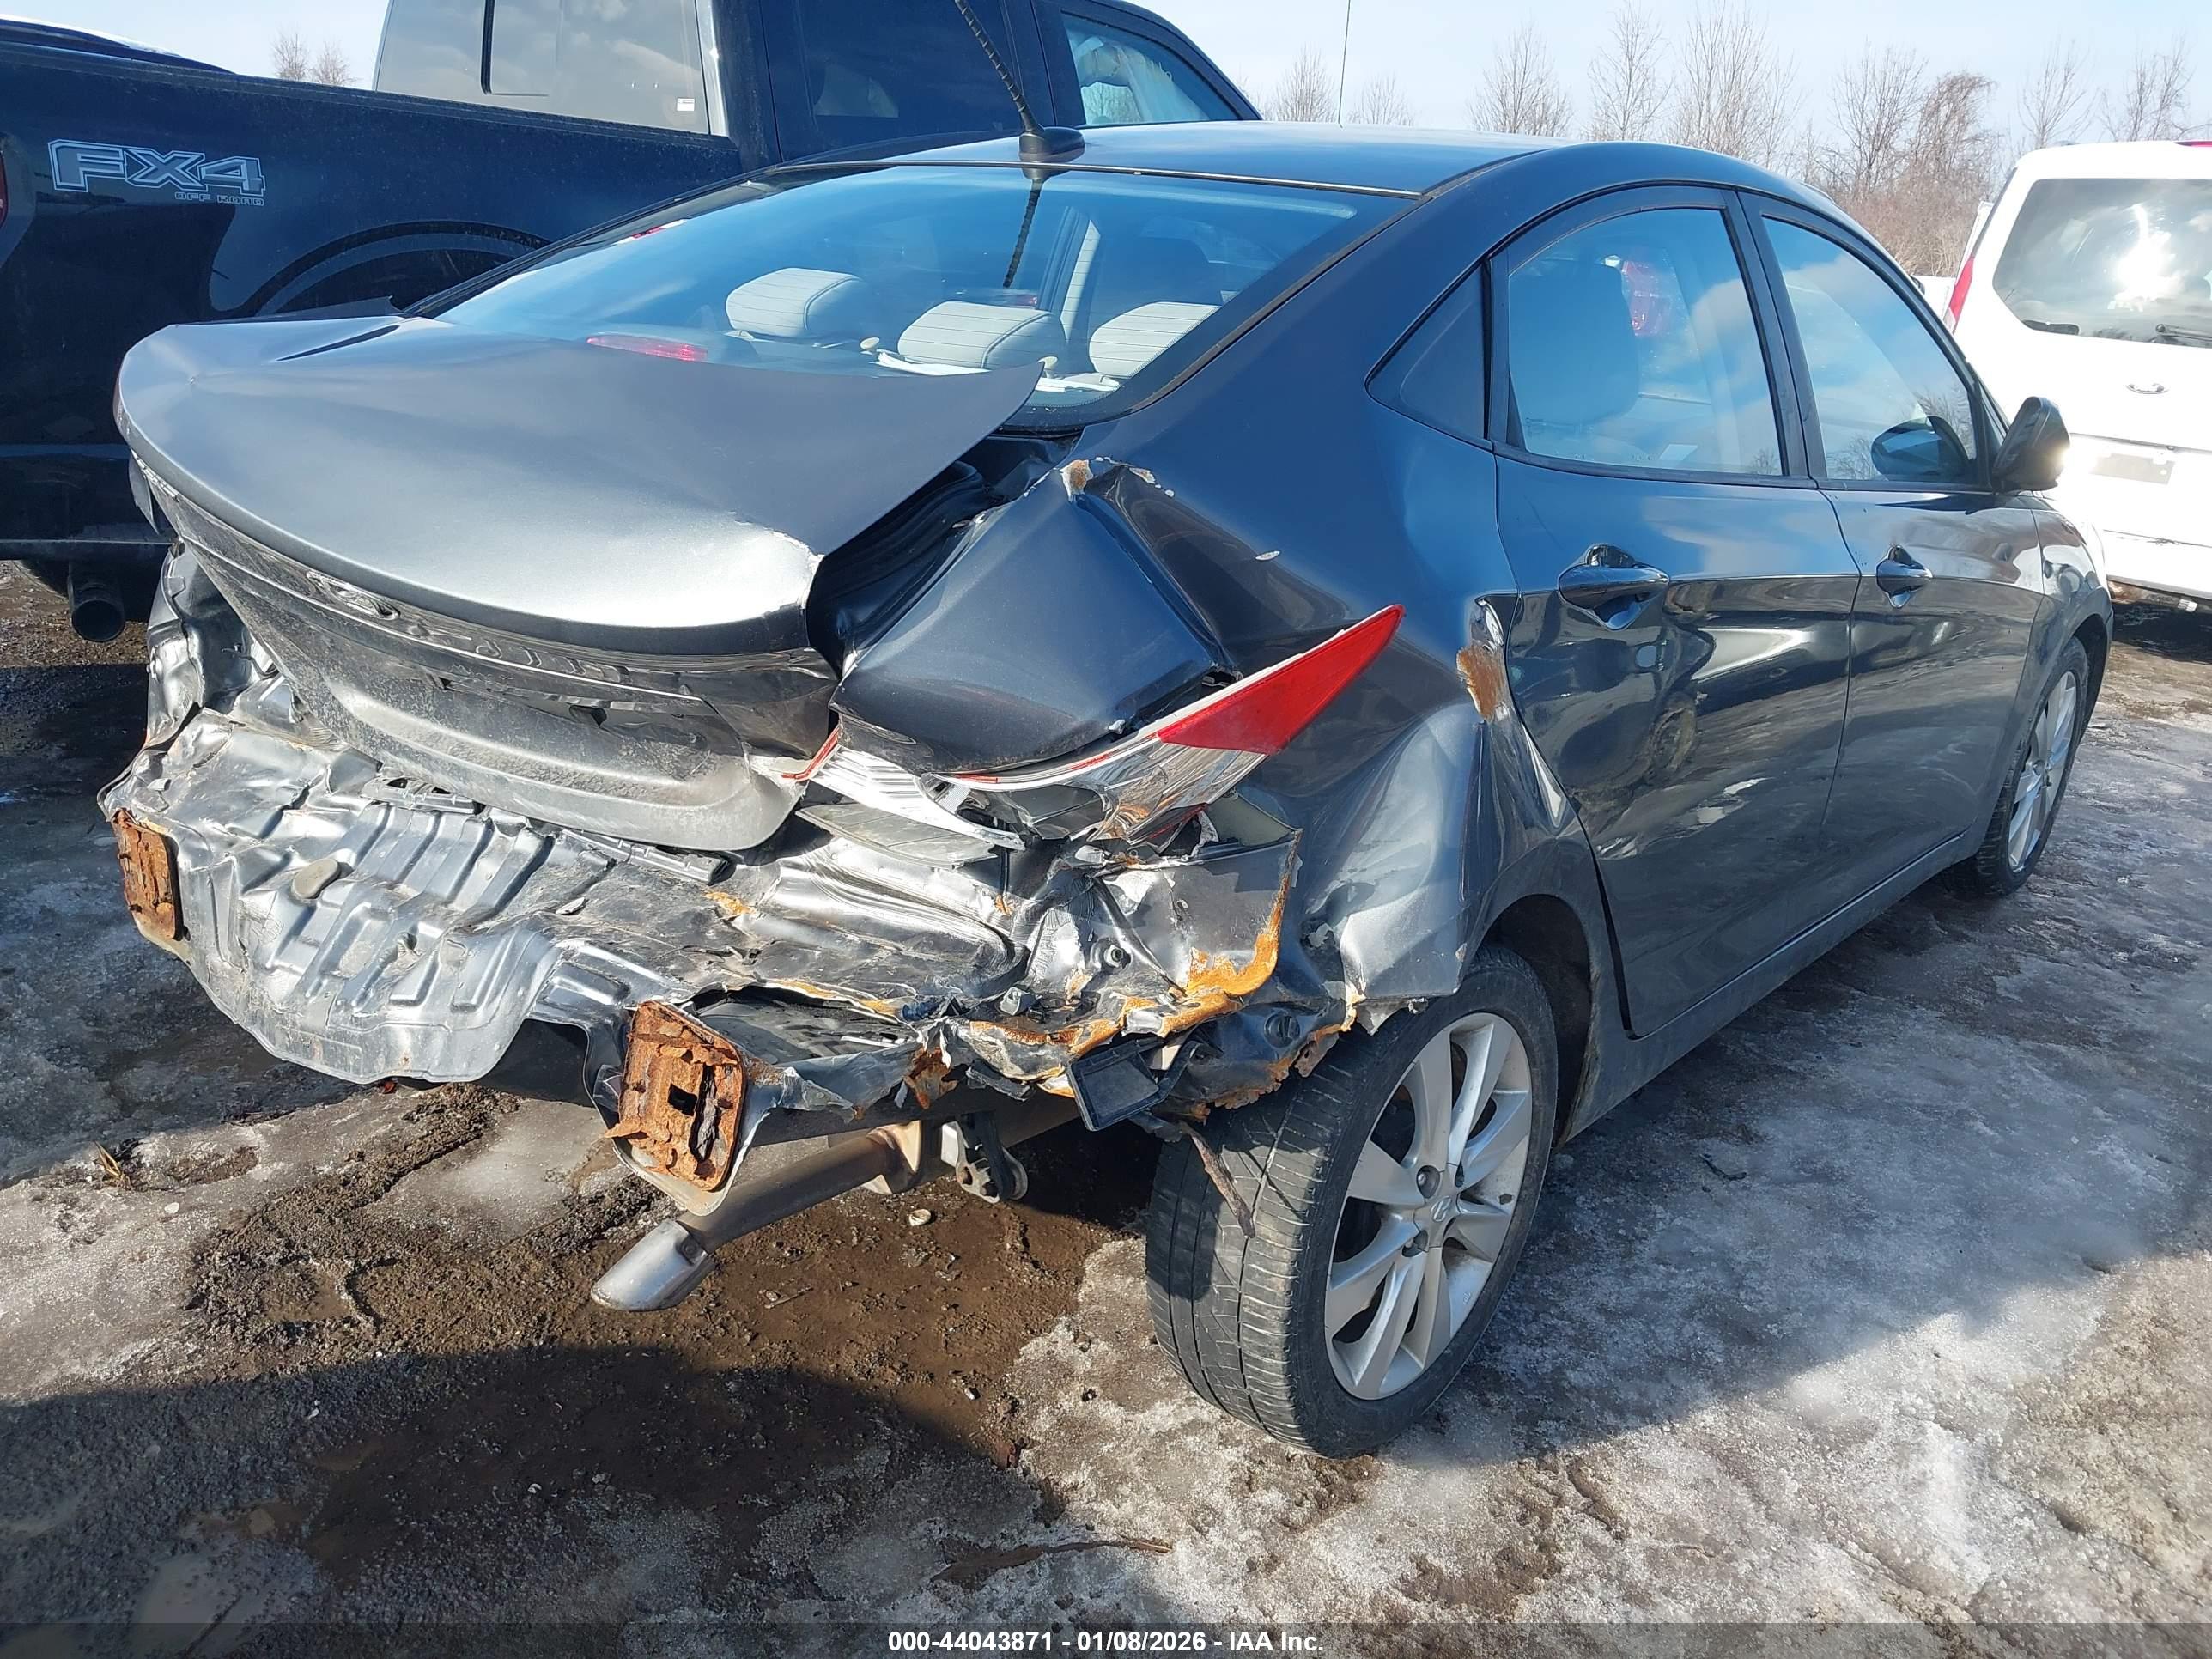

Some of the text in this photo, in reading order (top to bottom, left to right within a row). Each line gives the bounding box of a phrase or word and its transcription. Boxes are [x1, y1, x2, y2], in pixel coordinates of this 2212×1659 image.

[48, 138, 265, 197] FX4
[174, 191, 264, 206] OFF ROAD
